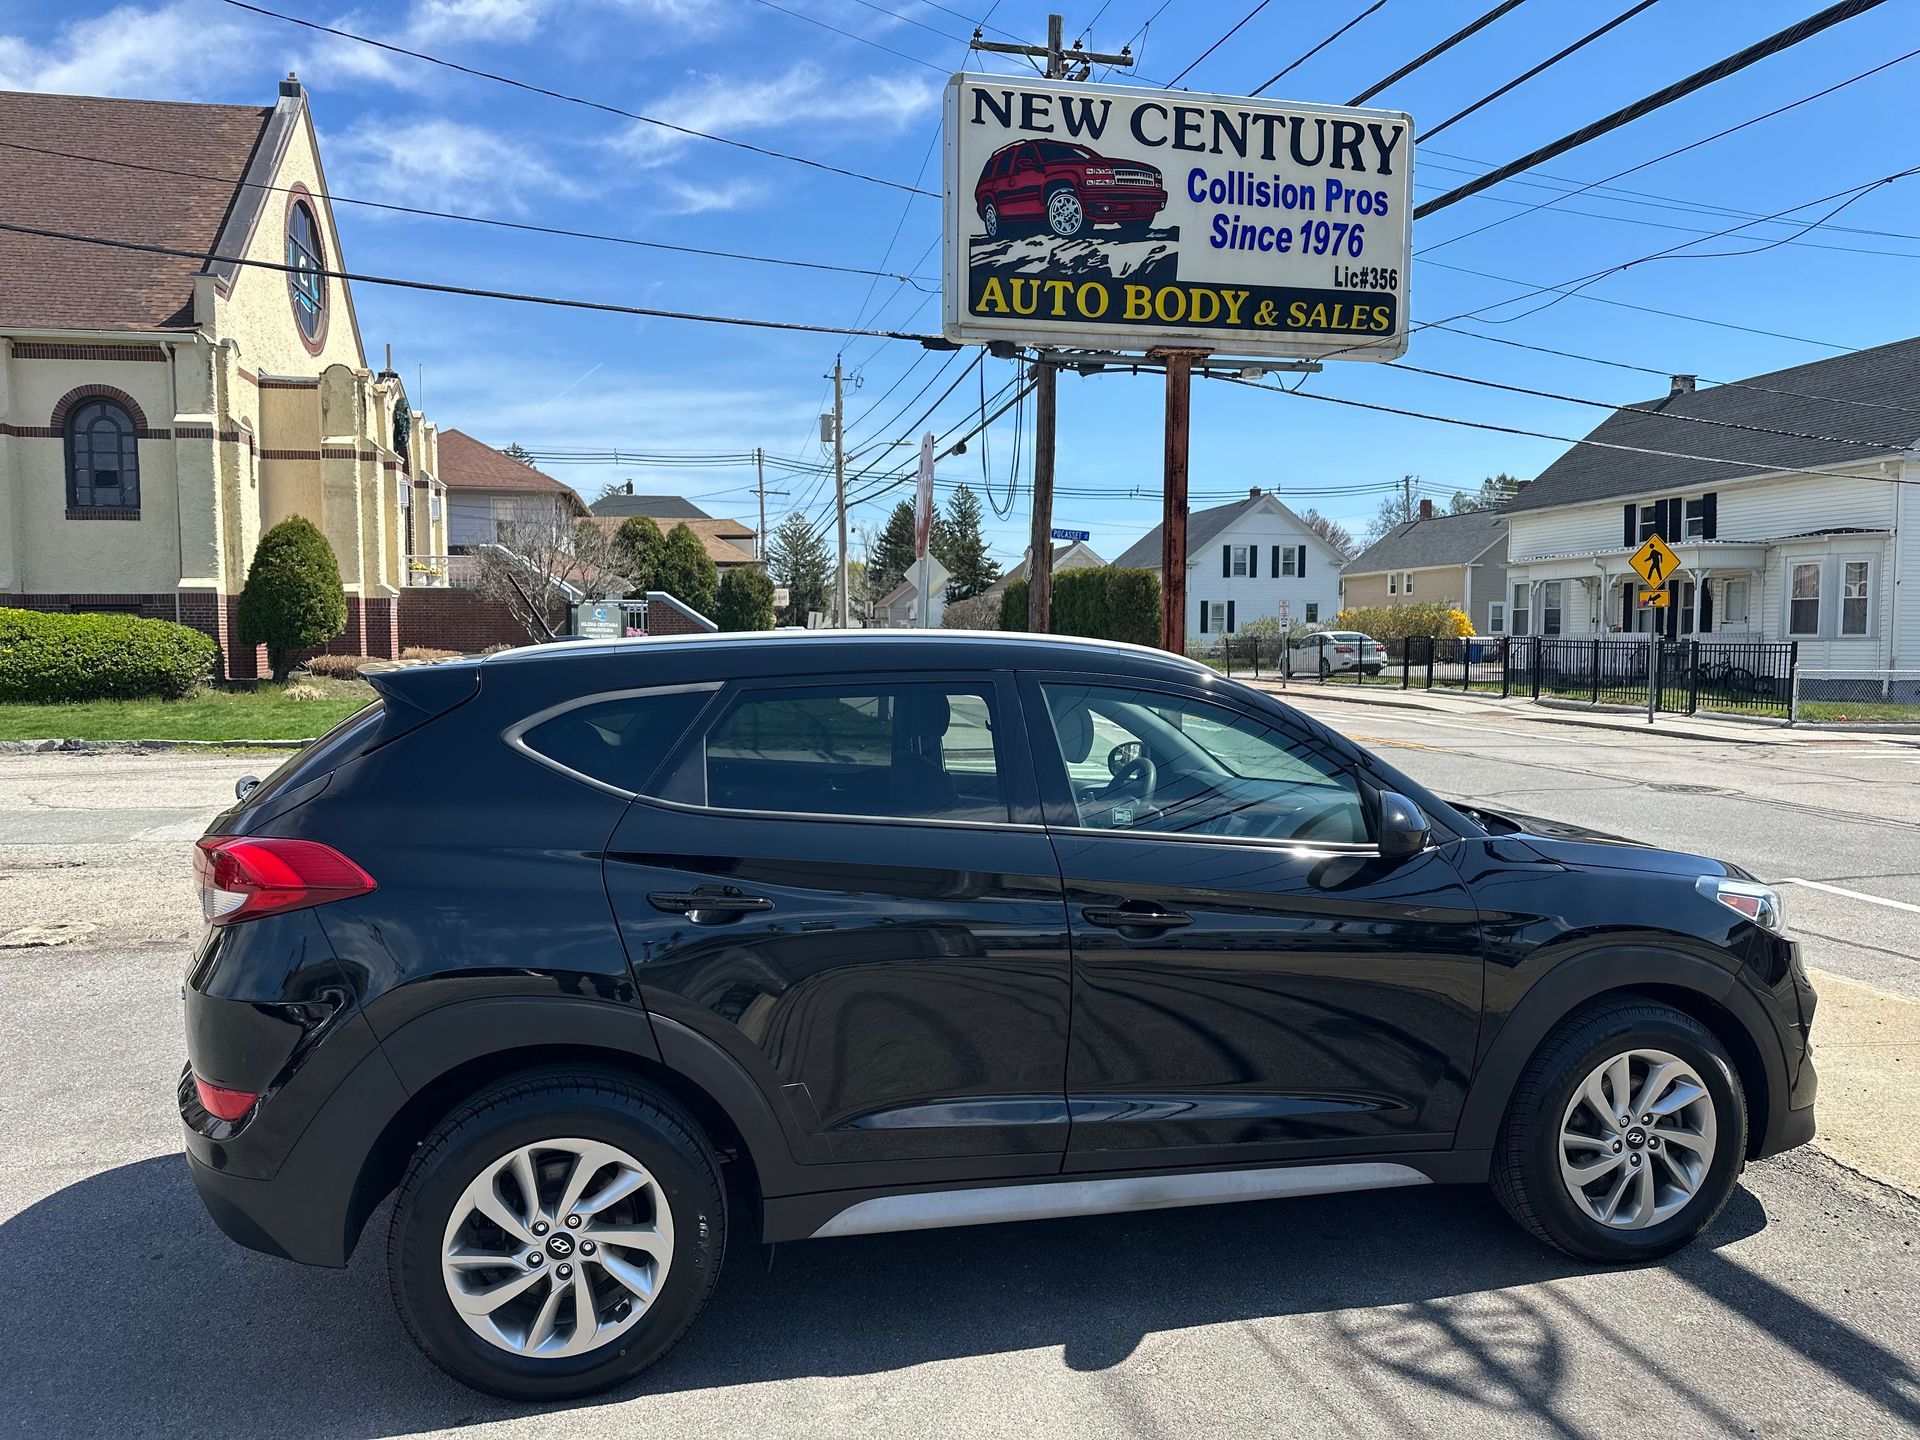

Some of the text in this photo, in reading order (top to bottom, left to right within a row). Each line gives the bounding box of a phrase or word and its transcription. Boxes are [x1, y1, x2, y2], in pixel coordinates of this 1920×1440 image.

[971, 88, 1404, 175] NEW CENTURY
[1187, 167, 1389, 217] Collision Pros
[1209, 213, 1366, 258] Since 1976
[1334, 265, 1398, 291] Lic#356
[976, 277, 1389, 330] AUTO BODY & SALES
